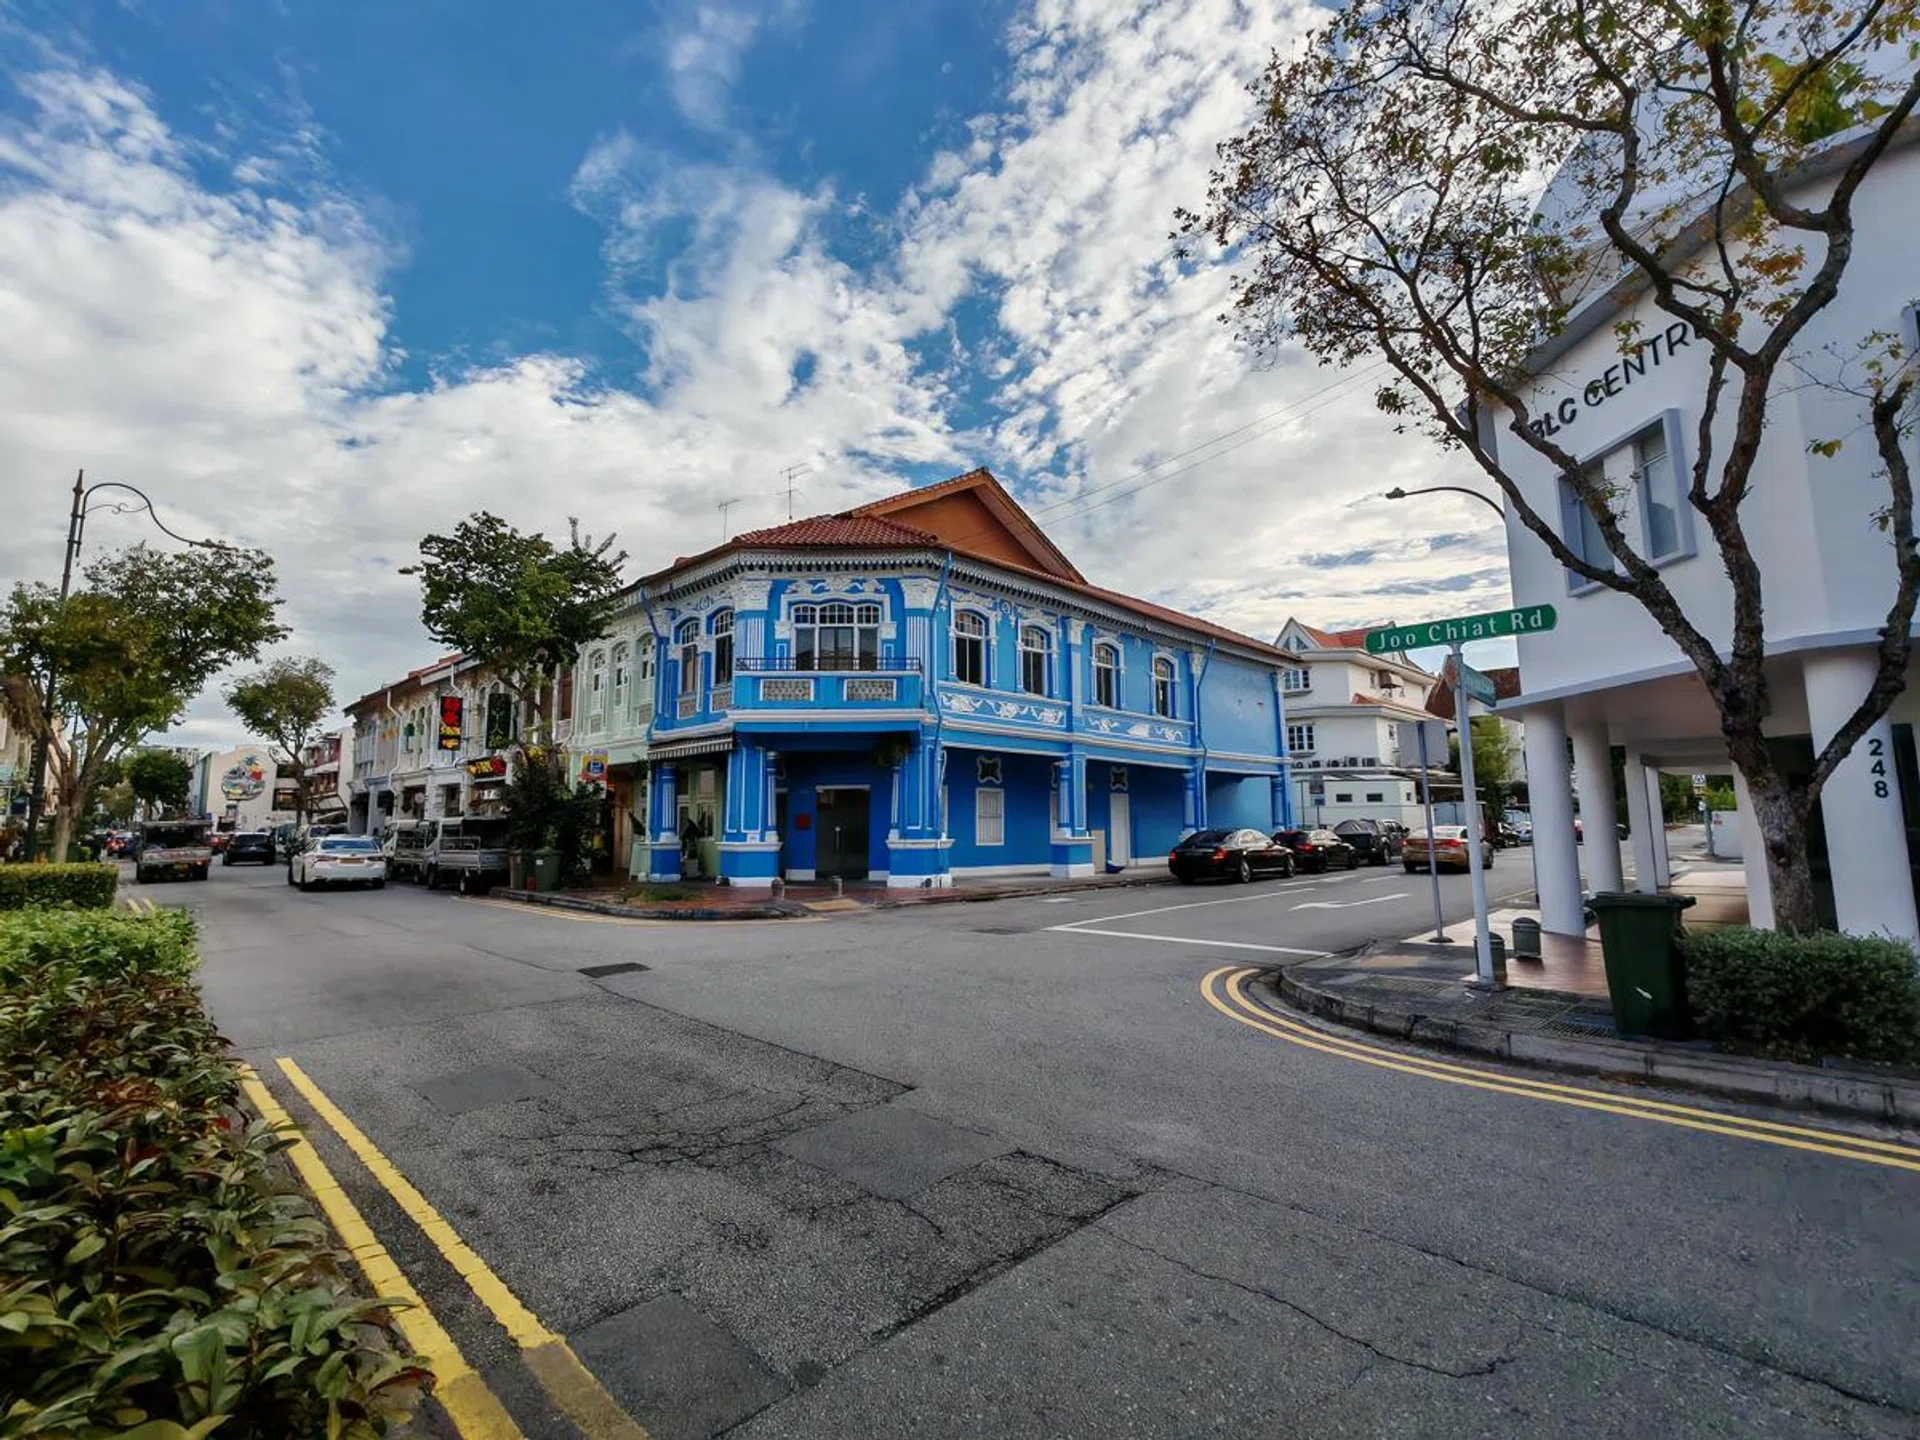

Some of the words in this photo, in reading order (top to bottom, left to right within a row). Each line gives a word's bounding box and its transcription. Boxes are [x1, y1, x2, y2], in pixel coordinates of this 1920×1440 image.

[1583, 321, 1698, 407] CENTR
[1378, 633, 1416, 649] Joo
[1428, 618, 1498, 642] Chiat
[1510, 609, 1543, 631] Rd
[1868, 739, 1889, 798] 248
